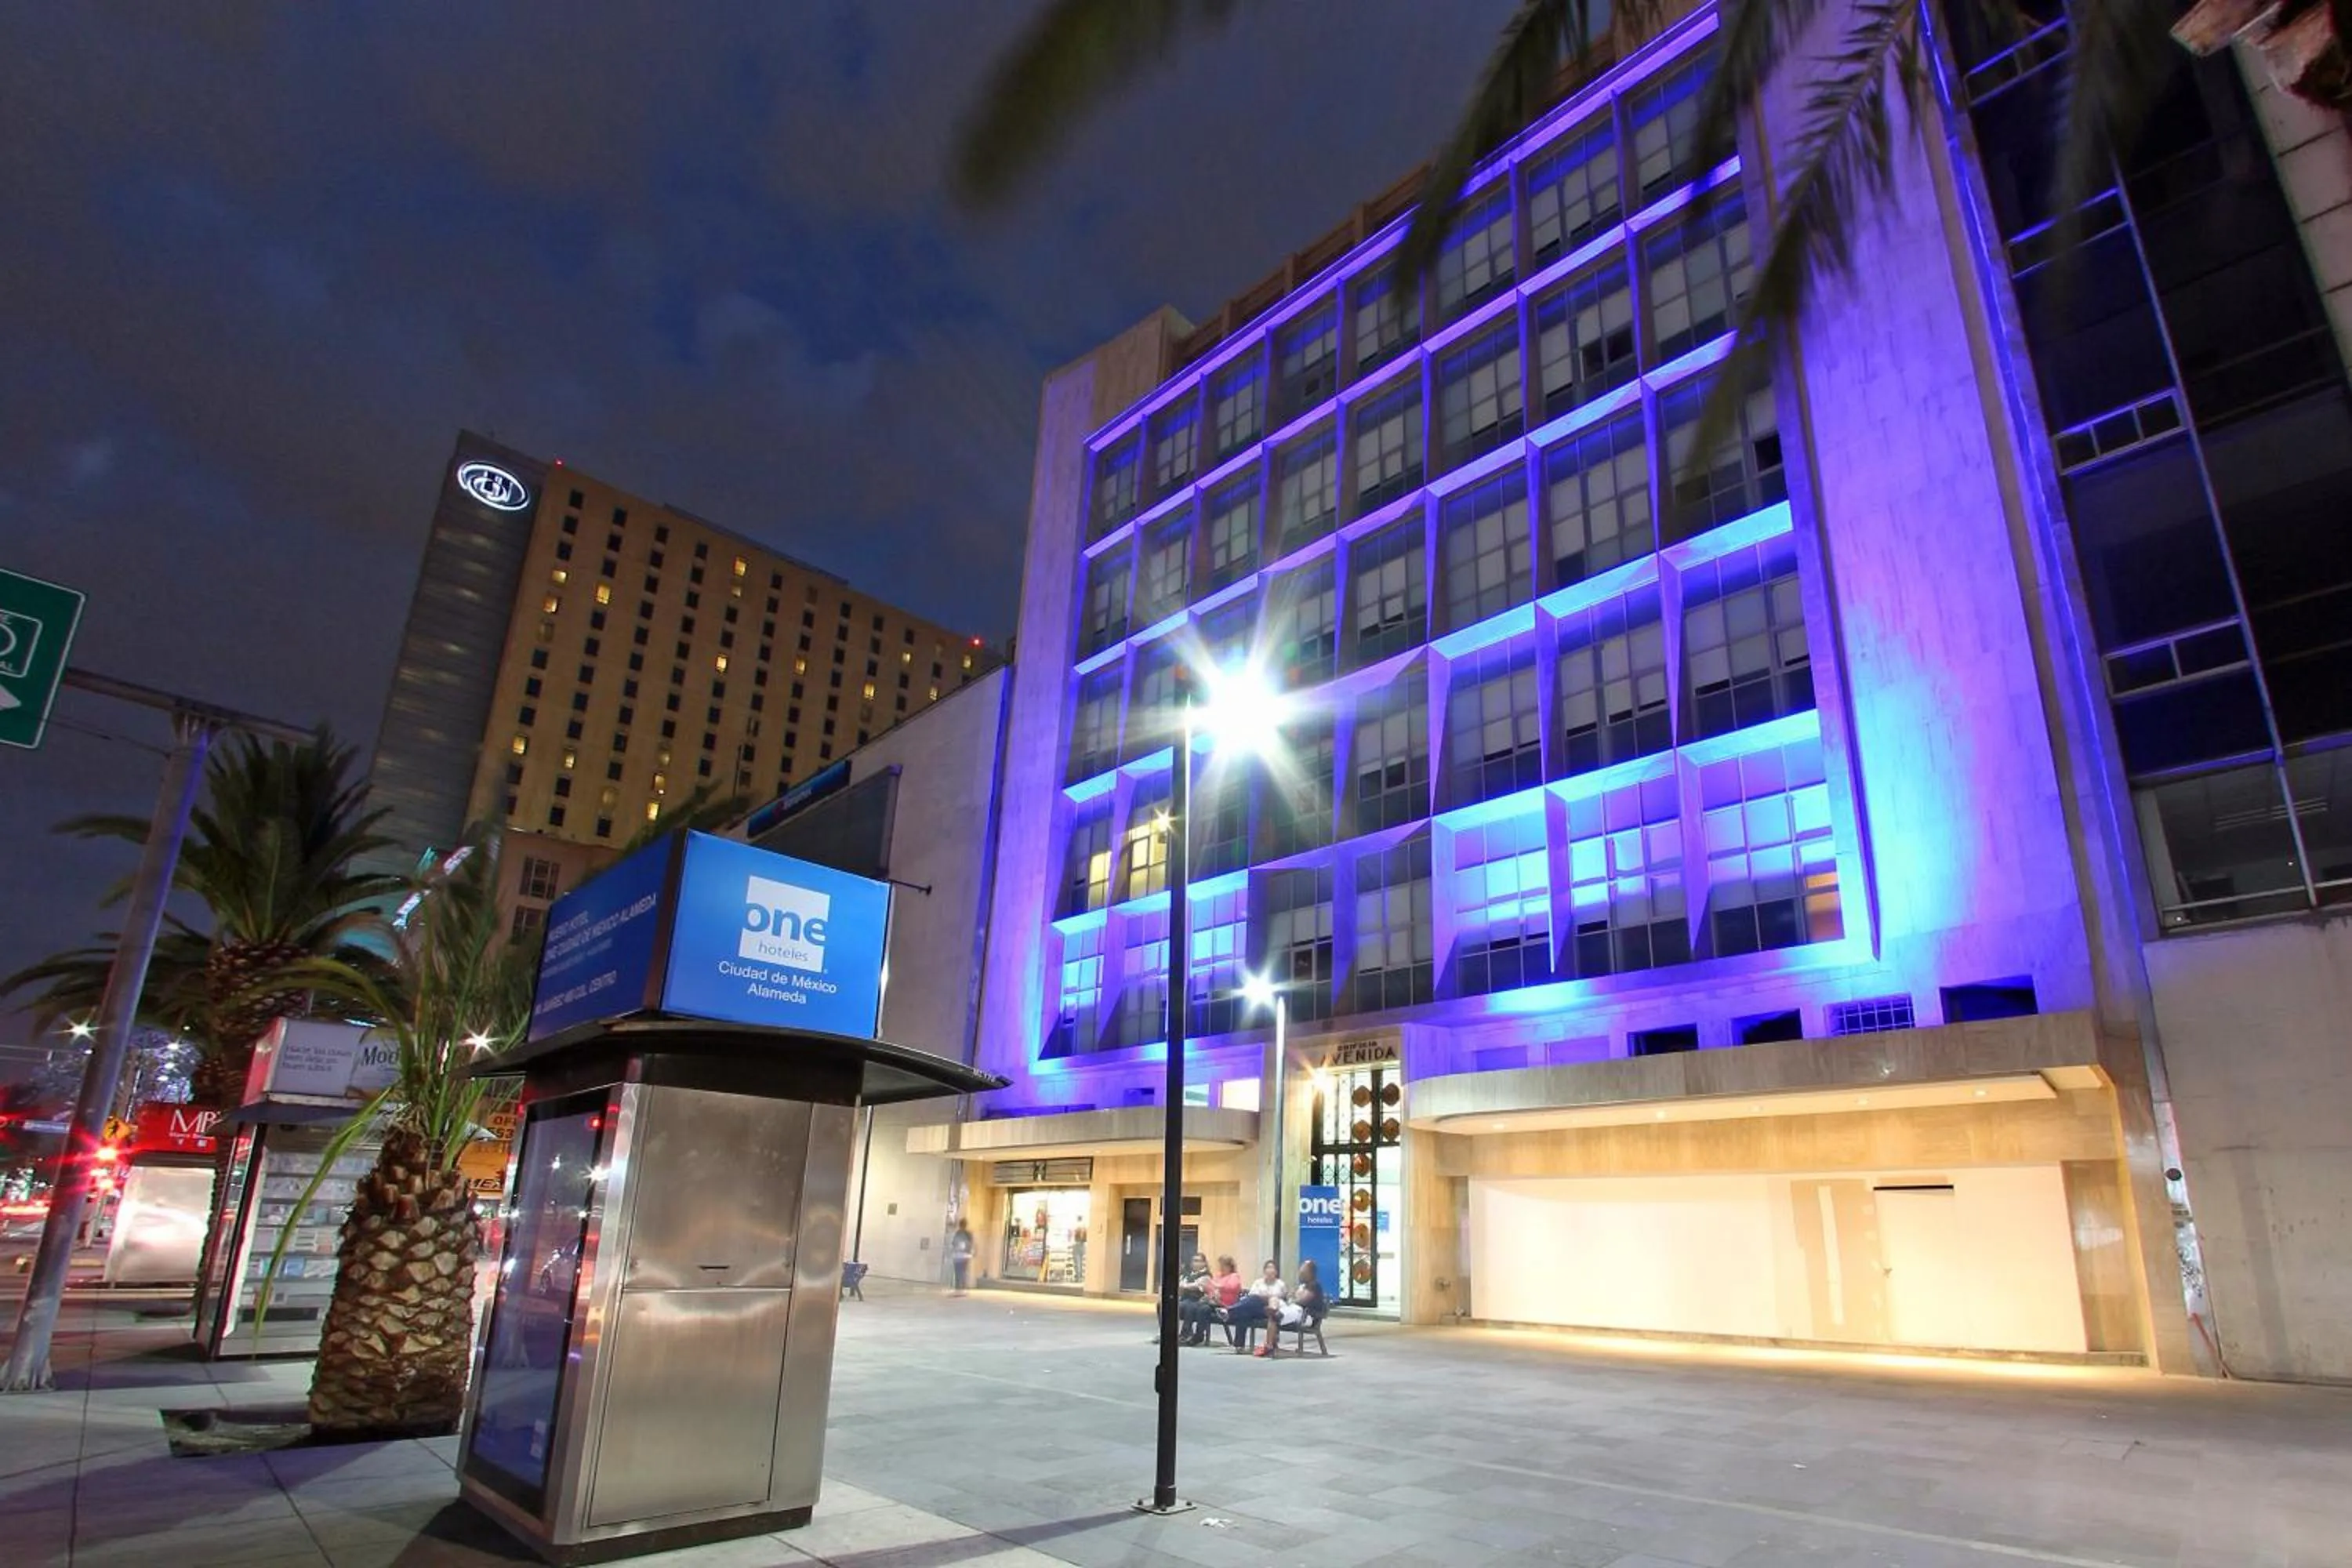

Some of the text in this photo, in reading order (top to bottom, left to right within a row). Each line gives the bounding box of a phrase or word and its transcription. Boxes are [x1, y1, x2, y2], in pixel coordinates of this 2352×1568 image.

[745, 903, 827, 946] one
[757, 941, 809, 962] hoteles
[718, 960, 837, 993] Ciudad de México
[747, 982, 807, 1004] Alameda
[1299, 1197, 1342, 1214] one
